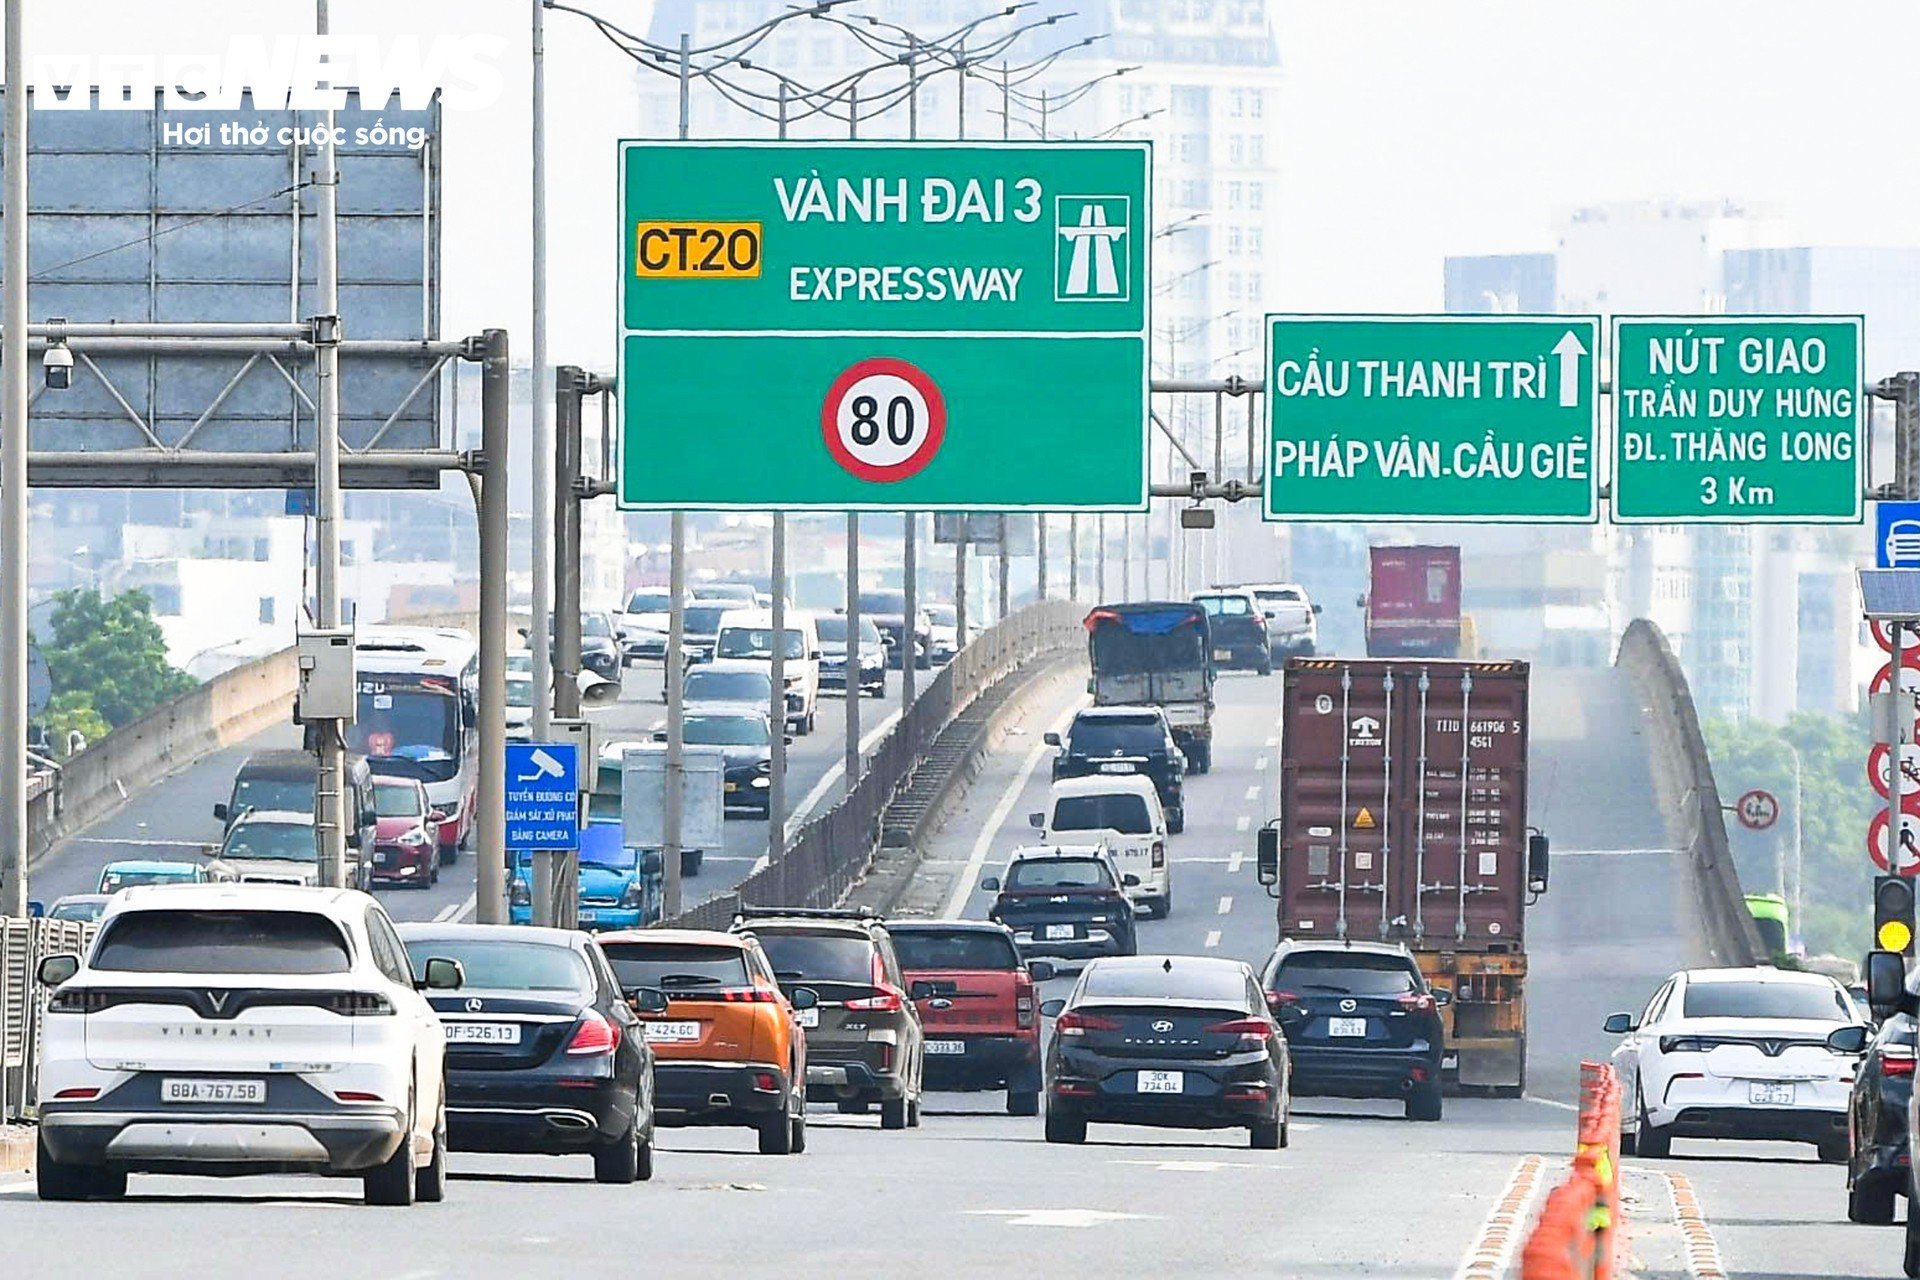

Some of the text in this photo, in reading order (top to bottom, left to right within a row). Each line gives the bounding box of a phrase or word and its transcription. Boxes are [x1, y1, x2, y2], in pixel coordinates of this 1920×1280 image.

[774, 169, 1042, 223] VÀNH ĐAI 3
[640, 228, 758, 271] CT.20
[790, 266, 1023, 302] EXPRESSWAY
[1277, 347, 1547, 399] CẦU THANH TRÌ
[1649, 328, 1826, 375] NÚT GIAO
[850, 395, 915, 446] 80
[1623, 379, 1852, 418] TRẦN DUY HƯNG
[1275, 434, 1369, 478] PHÁP
[1530, 435, 1588, 479] GIẼ
[1624, 427, 1852, 462] ĐL. THĂNG LONG
[1700, 476, 1774, 505] 3 Km
